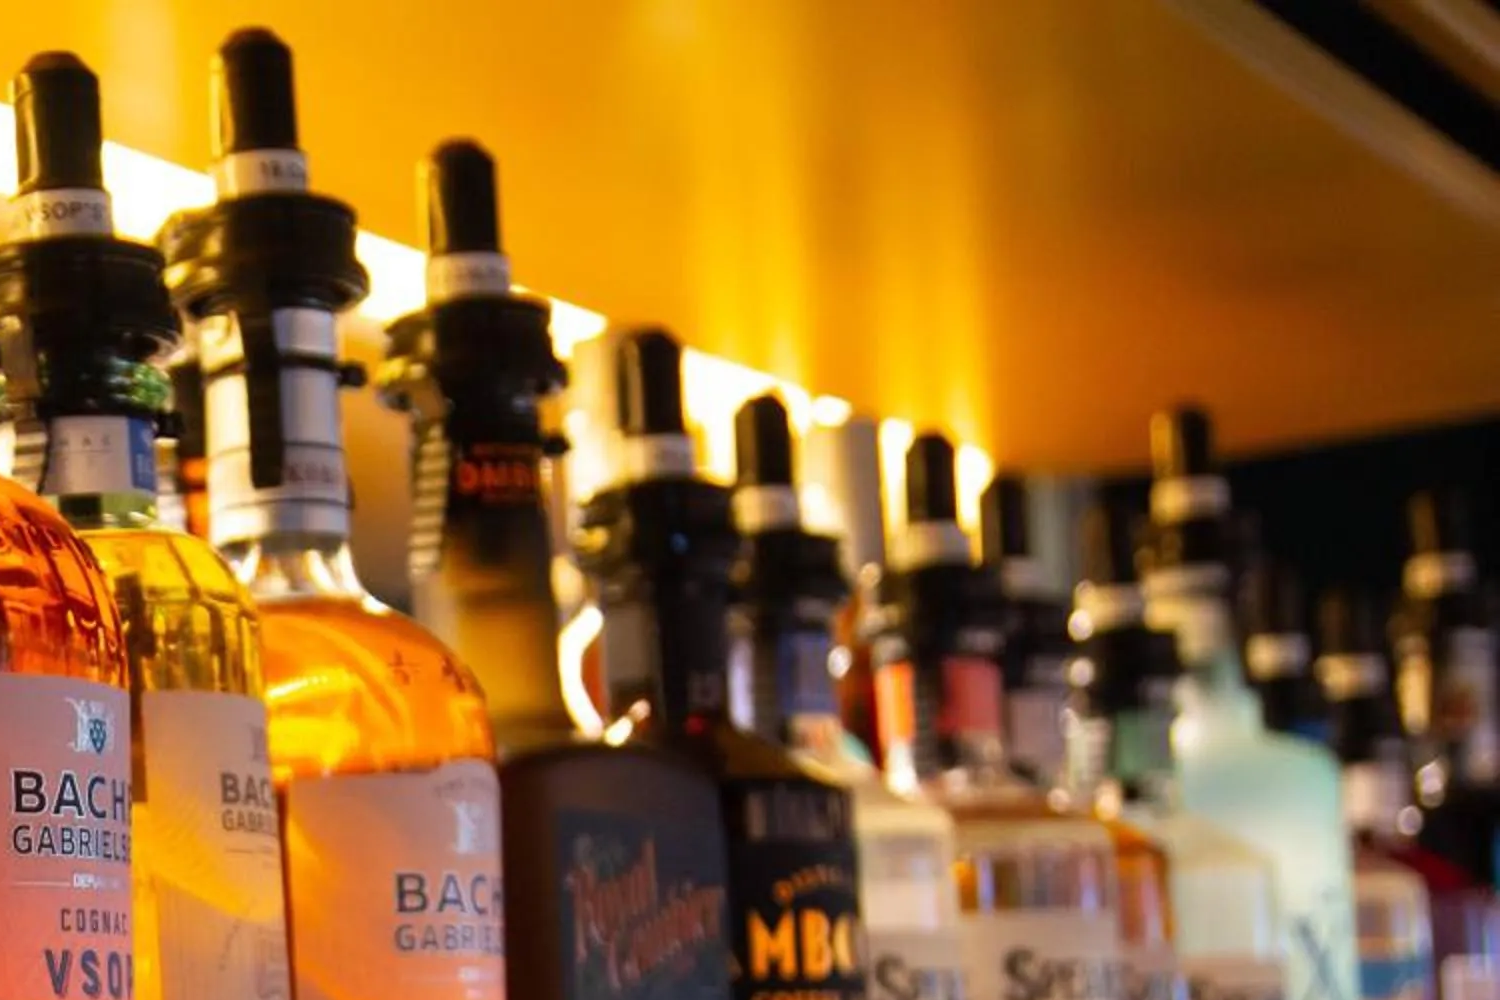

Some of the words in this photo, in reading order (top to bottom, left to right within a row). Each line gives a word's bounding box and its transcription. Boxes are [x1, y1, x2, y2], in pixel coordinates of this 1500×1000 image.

[12, 770, 132, 822] BACH
[12, 825, 132, 865] GABRIELS
[60, 907, 129, 936] COGNAC
